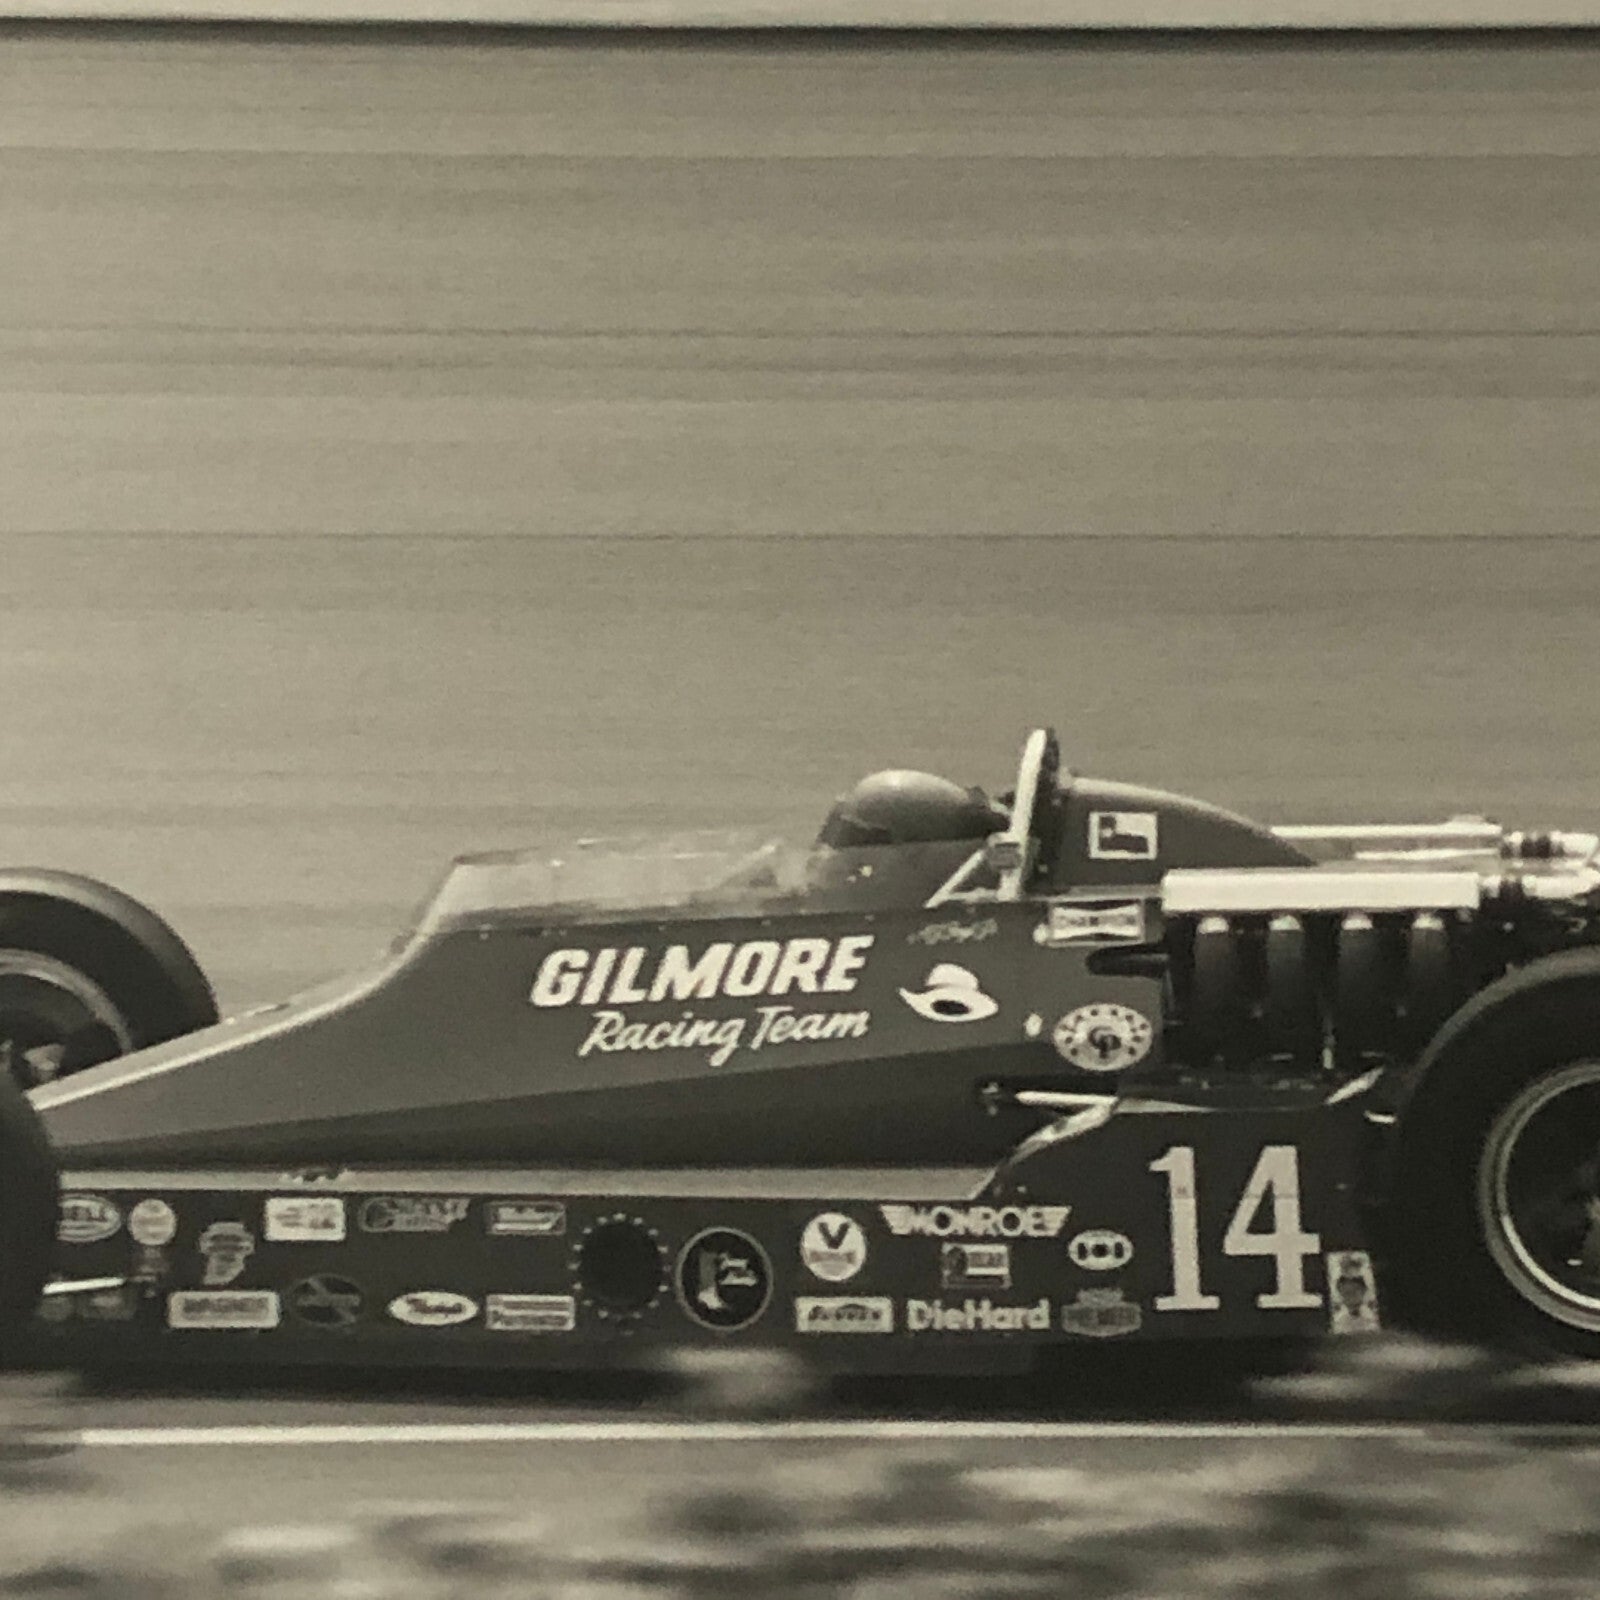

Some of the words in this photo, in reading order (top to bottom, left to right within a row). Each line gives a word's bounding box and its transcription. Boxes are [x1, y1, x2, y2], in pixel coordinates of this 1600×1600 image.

[530, 934, 875, 1008] GILMORE
[577, 1009, 746, 1067] Racing
[750, 1005, 871, 1051] Team
[905, 1204, 1054, 1238] MONROE
[1148, 1144, 1323, 1311] 14
[906, 1298, 1051, 1331] DieHard
